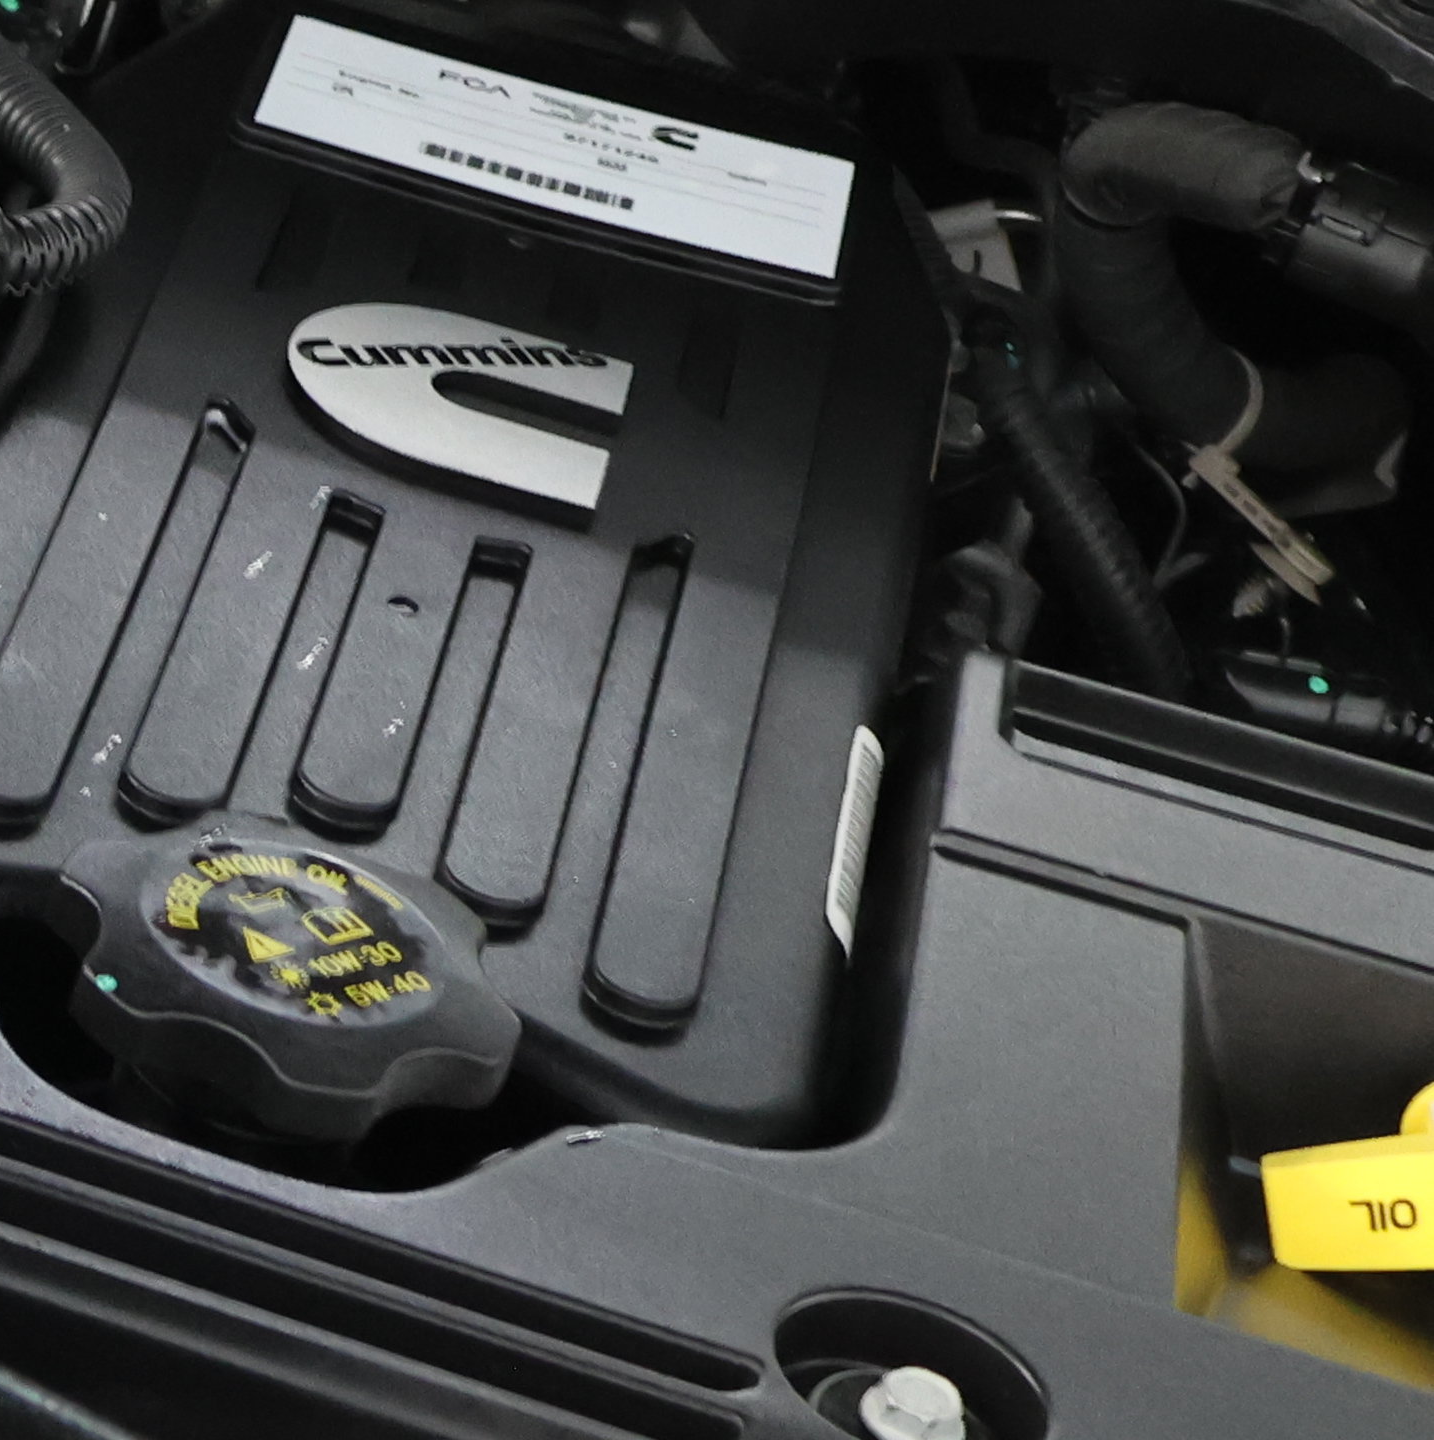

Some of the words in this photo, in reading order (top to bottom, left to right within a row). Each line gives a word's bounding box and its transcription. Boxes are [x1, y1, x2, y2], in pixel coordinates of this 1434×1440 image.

[296, 336, 610, 371] Cummins
[165, 872, 214, 930] DIESEL
[196, 854, 299, 882] ENGINE
[308, 940, 403, 978] 10W-30
[343, 970, 432, 1008] 5W-40
[1349, 1198, 1417, 1232] OIL
